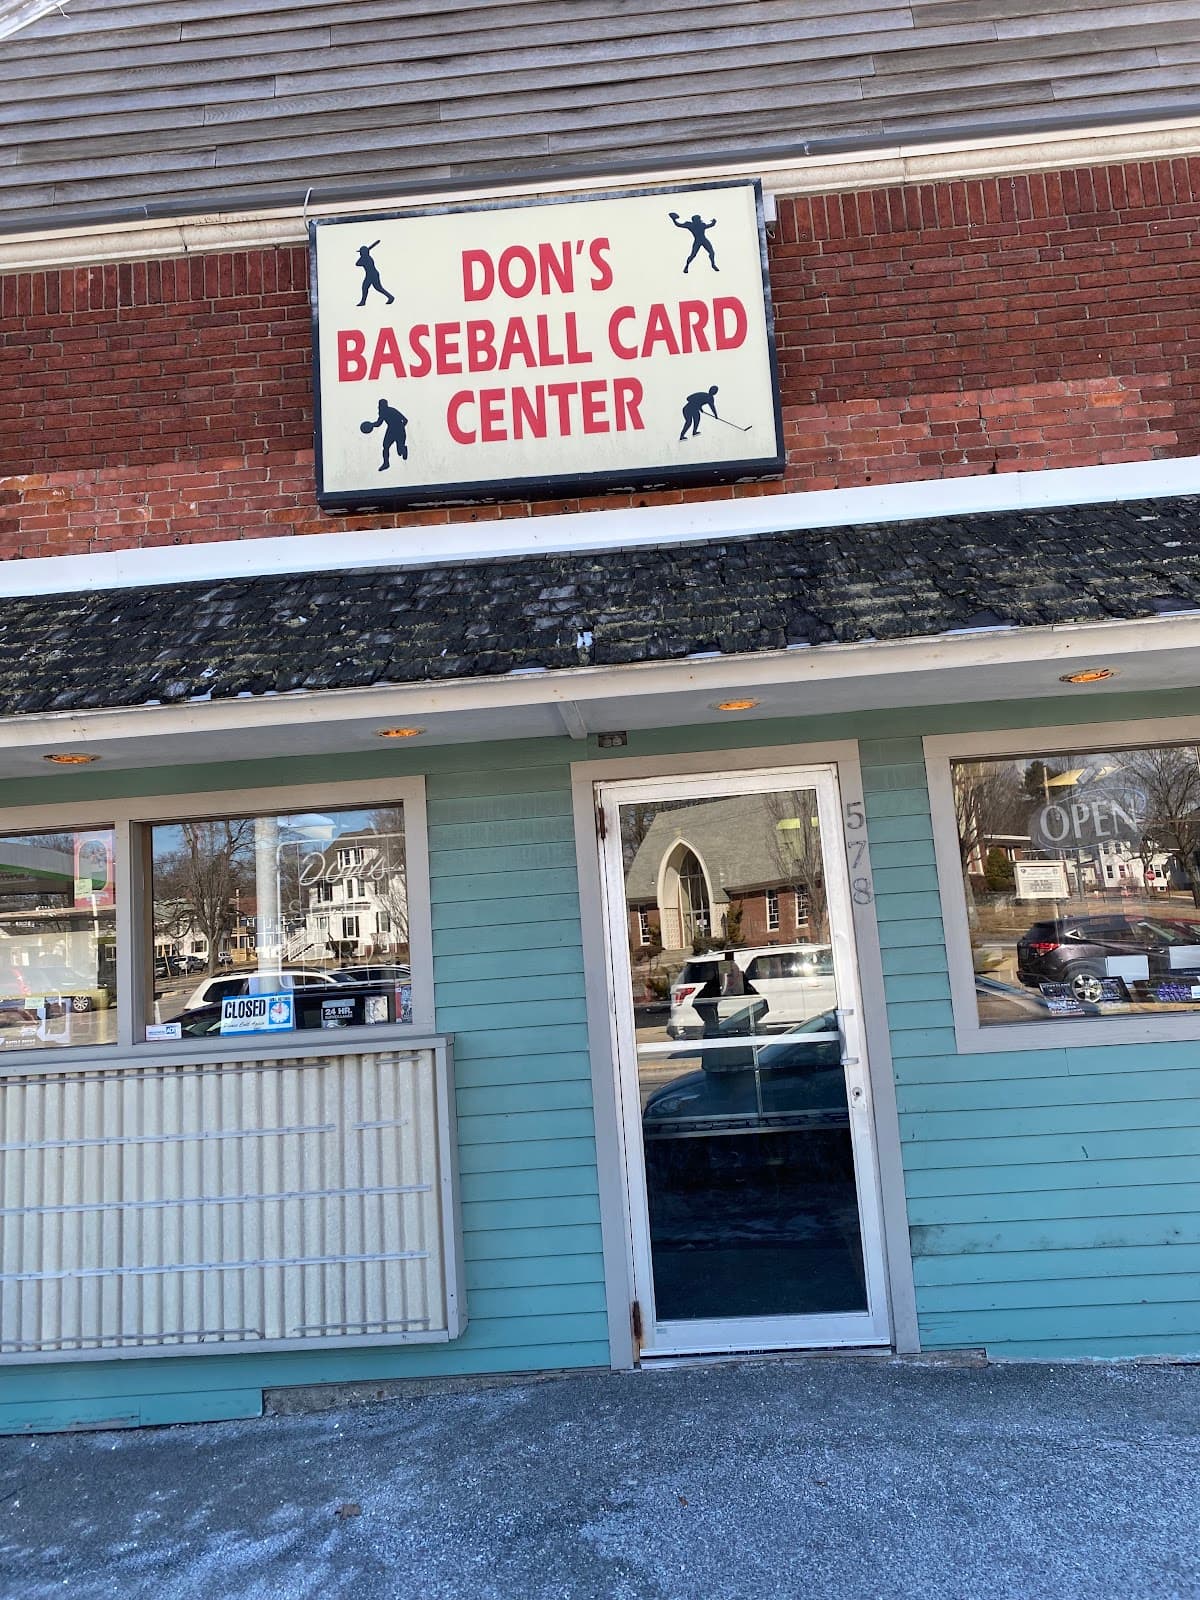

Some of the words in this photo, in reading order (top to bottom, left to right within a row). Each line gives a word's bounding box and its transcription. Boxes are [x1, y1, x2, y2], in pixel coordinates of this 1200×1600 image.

[462, 237, 614, 302] DON'S
[337, 311, 592, 382] BASEBALL
[608, 296, 748, 360] CARD
[446, 377, 646, 445] CENTER
[1040, 798, 1139, 841] OPEN
[847, 801, 872, 905] 578
[224, 999, 266, 1019] CLOSED
[324, 1007, 336, 1016] 24
